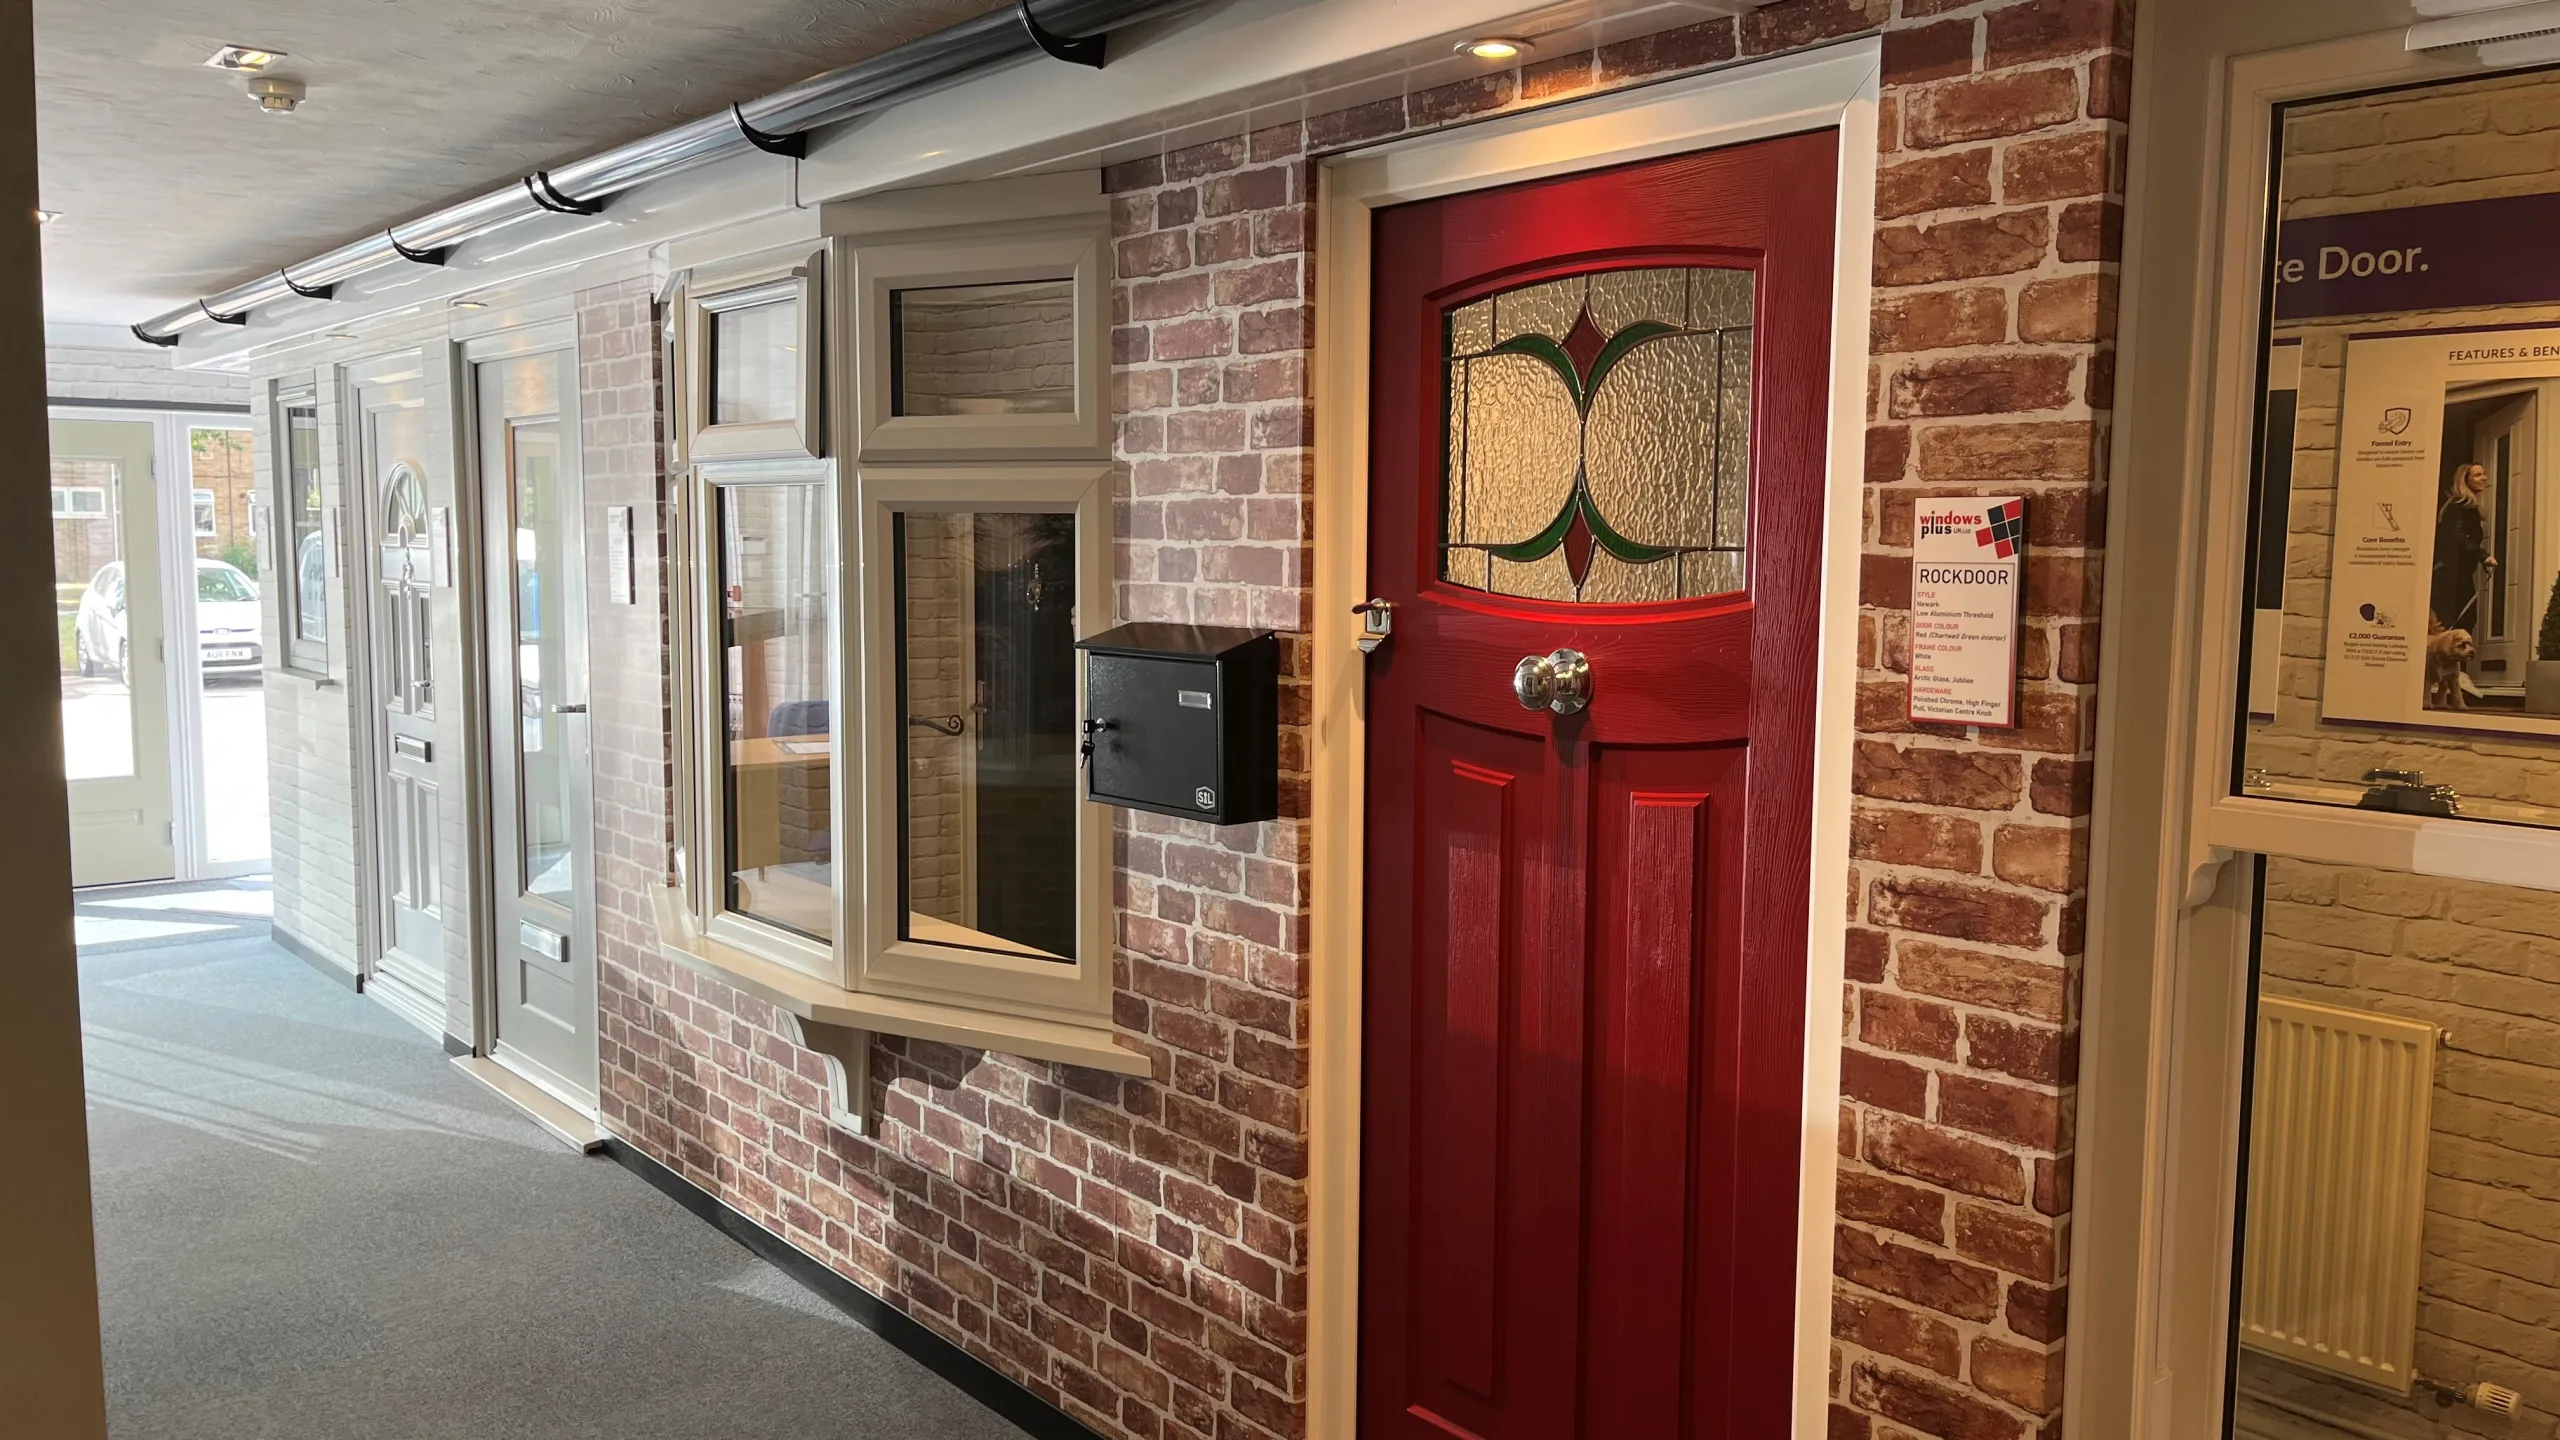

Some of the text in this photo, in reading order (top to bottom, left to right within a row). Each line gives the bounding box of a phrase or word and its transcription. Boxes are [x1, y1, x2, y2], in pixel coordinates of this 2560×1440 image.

[2319, 246, 2428, 280] Door.
[2449, 348, 2514, 360] FEATURES
[2519, 348, 2528, 357] &
[1920, 510, 1982, 525] windows
[1921, 522, 1952, 539] plus
[1920, 569, 2008, 585] ROCKDOOR
[1980, 634, 2006, 642] interior)
[1938, 644, 1962, 652] COLOUR
[1952, 676, 1974, 684] Jubilee
[1966, 699, 1979, 707] High
[1981, 700, 2001, 708] Finger
[1976, 709, 1993, 717] Knob
[1198, 791, 1213, 804] SIL
